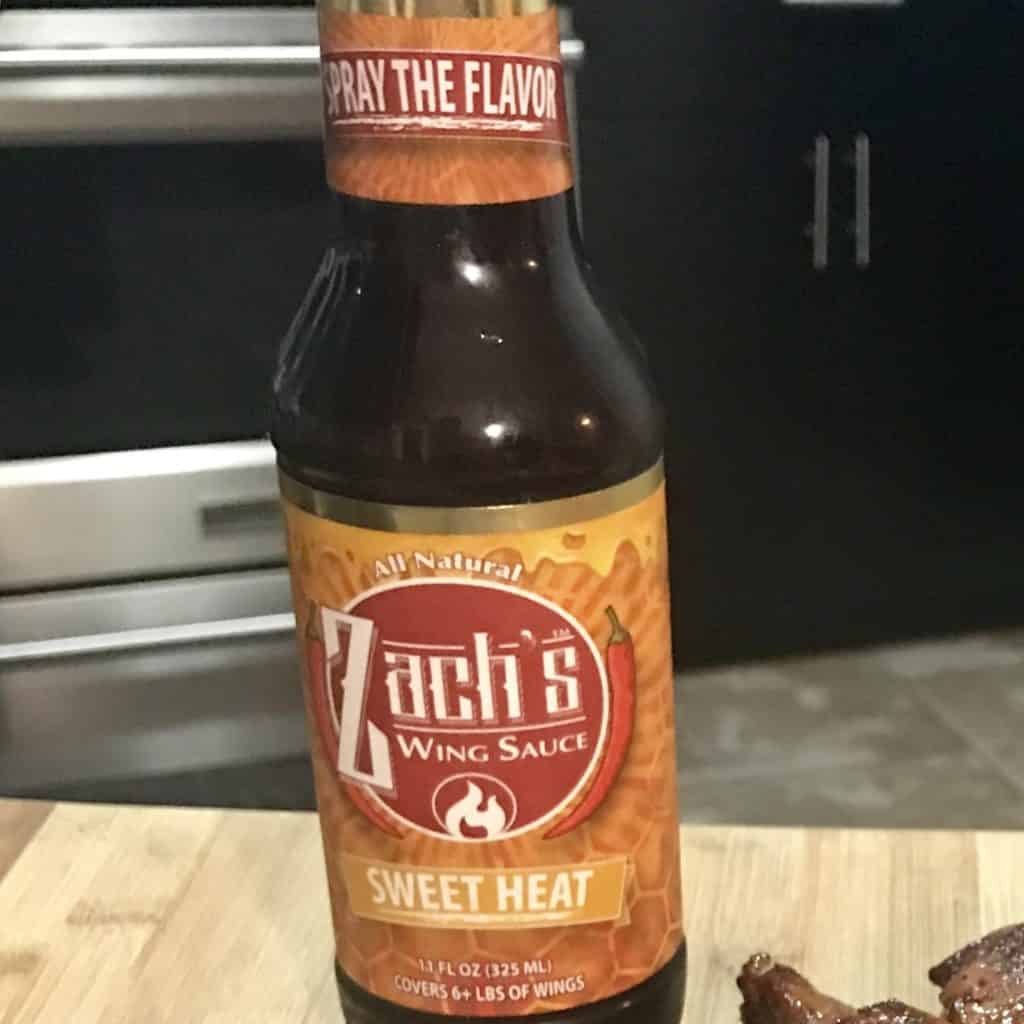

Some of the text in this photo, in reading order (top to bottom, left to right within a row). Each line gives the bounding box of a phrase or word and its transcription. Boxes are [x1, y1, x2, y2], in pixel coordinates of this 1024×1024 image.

[391, 59, 456, 112] THE
[464, 61, 557, 119] FLAVOR
[375, 551, 522, 582] All Natural
[321, 606, 580, 792] Zach's
[366, 867, 594, 913] SWEET HEAT
[394, 975, 585, 1002] COVERS 6+ LBS OF WINGS
[439, 961, 456, 976] FL
[459, 962, 481, 977] OZ
[485, 962, 519, 979] (325
